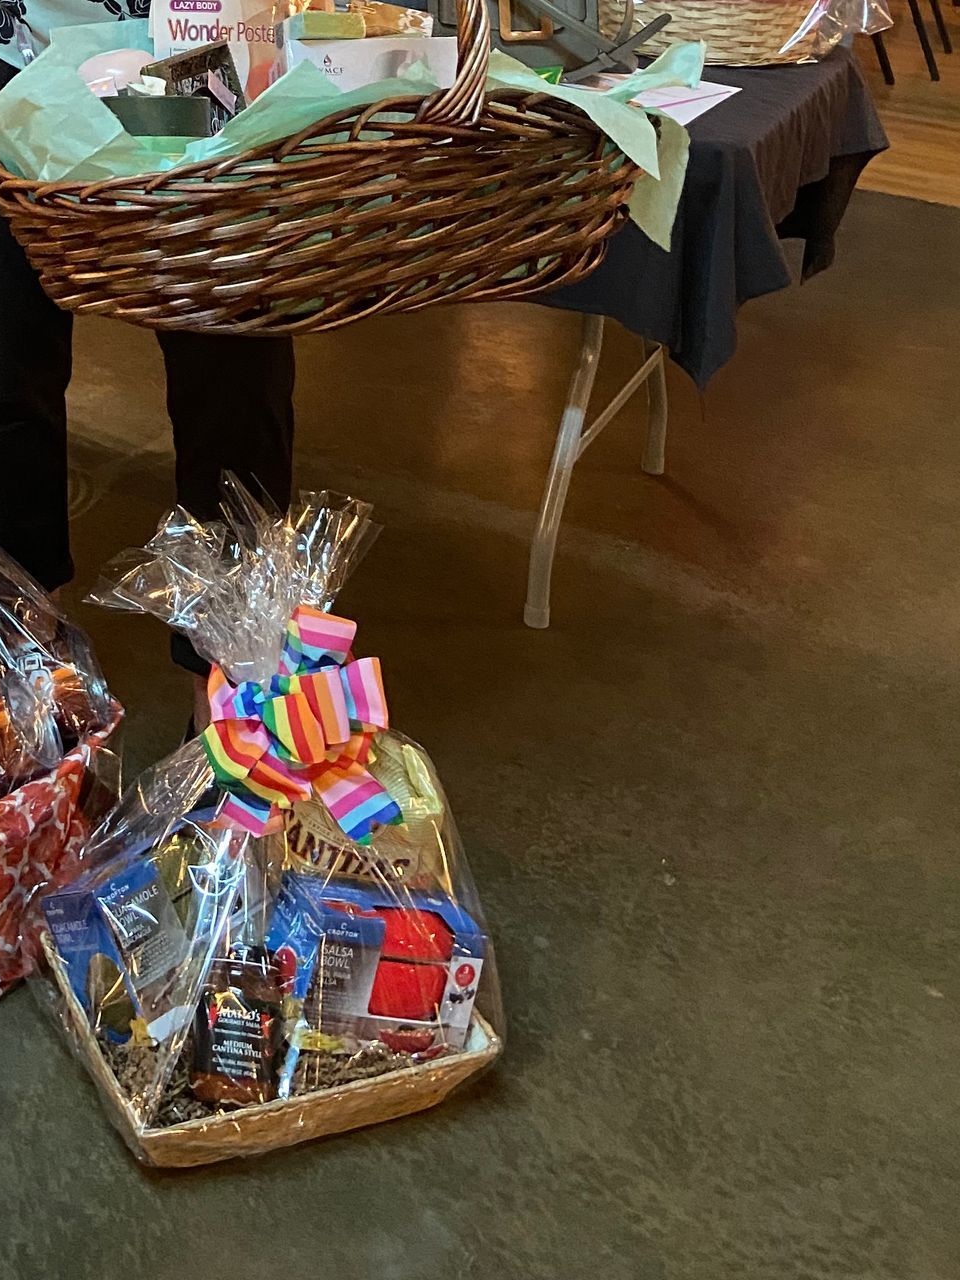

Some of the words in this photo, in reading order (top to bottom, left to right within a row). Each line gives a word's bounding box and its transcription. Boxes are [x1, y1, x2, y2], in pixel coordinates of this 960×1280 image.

[173, 1, 194, 10] LAZY
[196, 1, 218, 11] BODY
[167, 17, 234, 42] Wonder
[327, 929, 360, 939] CROFTON
[323, 944, 354, 958] SALSA
[223, 1039, 253, 1050] MEDIUM
[212, 1044, 243, 1055] CANTINA
[244, 1048, 262, 1059] STYLE
